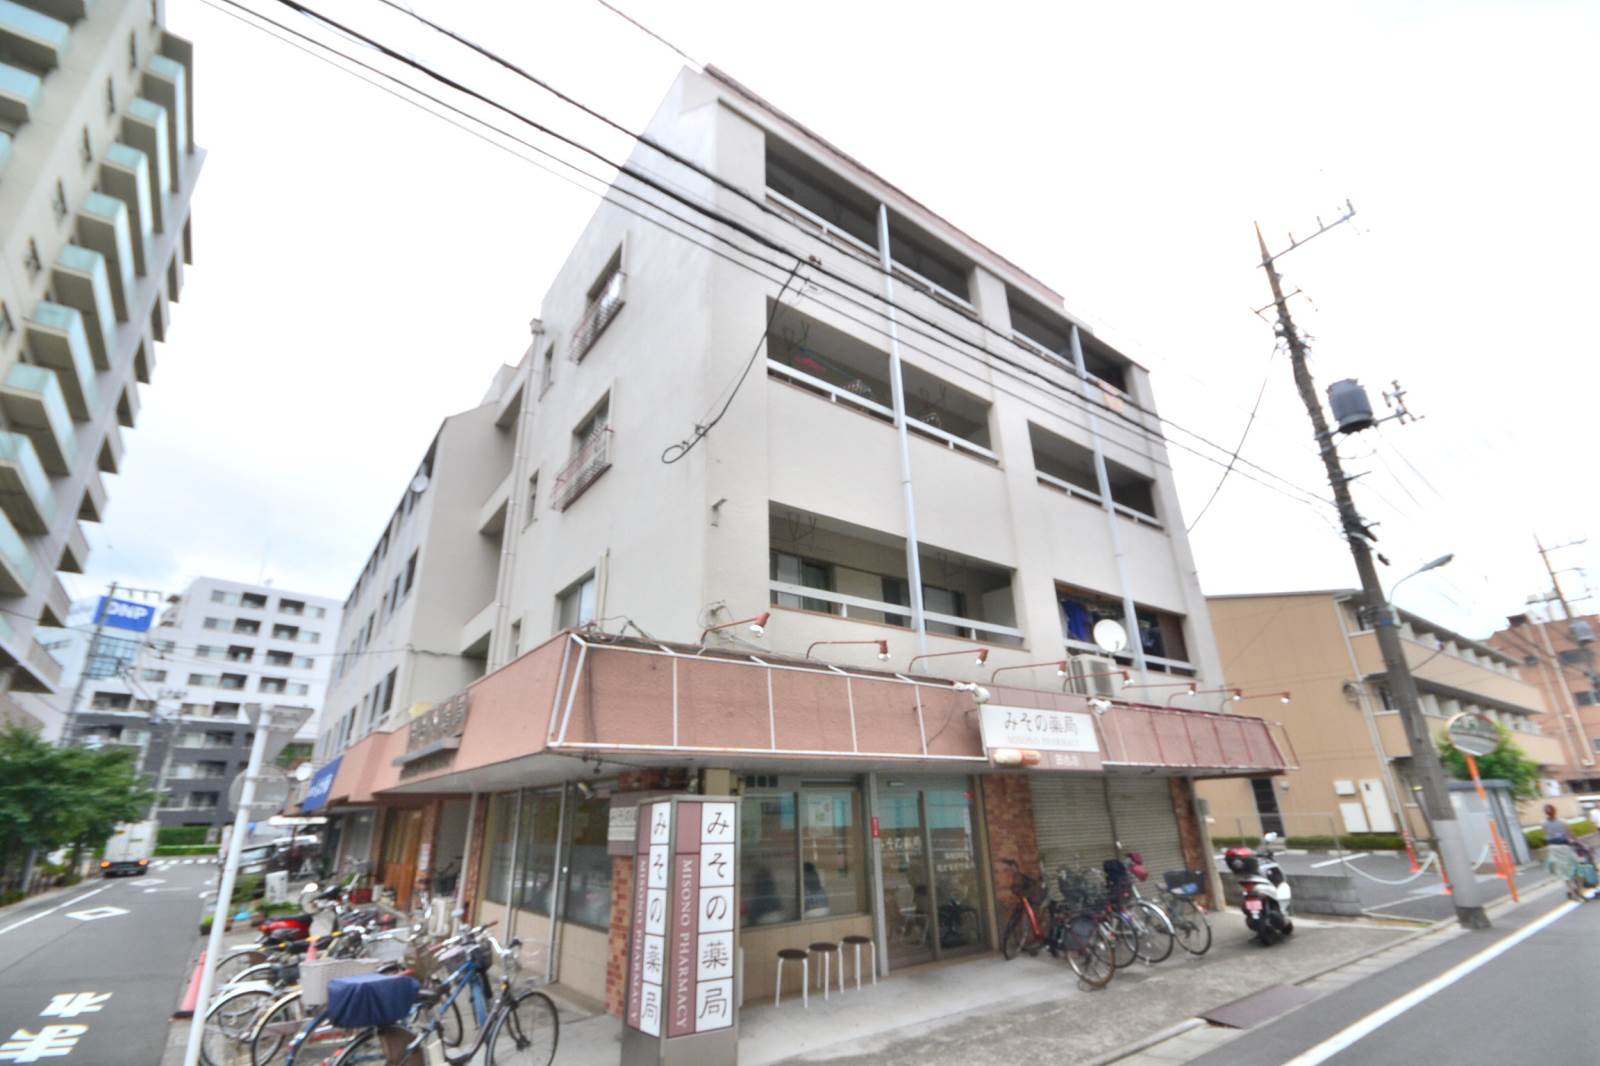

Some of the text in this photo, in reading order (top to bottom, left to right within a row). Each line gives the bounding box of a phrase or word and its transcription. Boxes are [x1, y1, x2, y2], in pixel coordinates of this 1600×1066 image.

[641, 811, 668, 1025] みその薬局
[675, 859, 693, 1028] MISONO PHARMACY
[699, 811, 730, 1020] みその薬局
